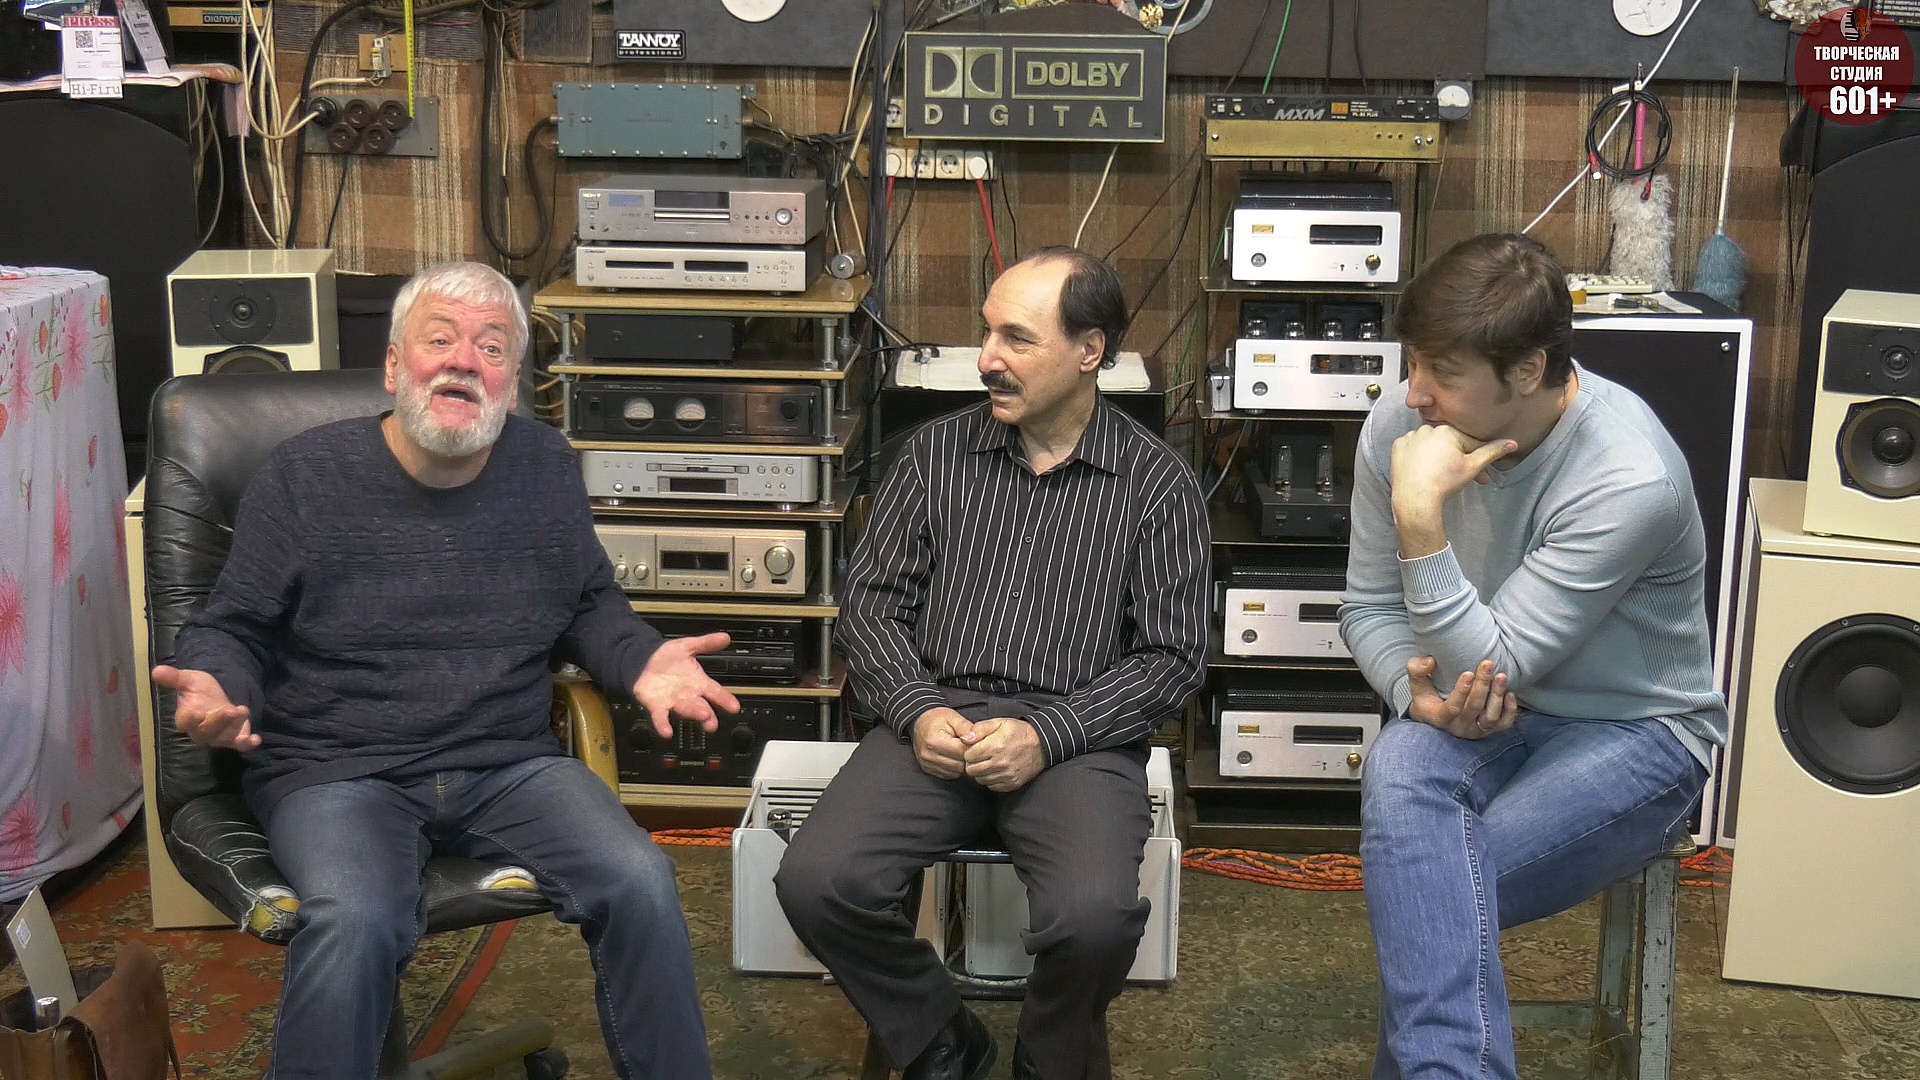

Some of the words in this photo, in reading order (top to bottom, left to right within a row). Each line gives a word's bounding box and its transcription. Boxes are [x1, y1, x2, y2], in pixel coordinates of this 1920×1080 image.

[67, 16, 116, 27] PRESS
[619, 33, 681, 47] TANNOY
[1026, 61, 1130, 88] DOLBY
[924, 104, 1143, 128] DIGITAL
[1274, 108, 1326, 121] MXM
